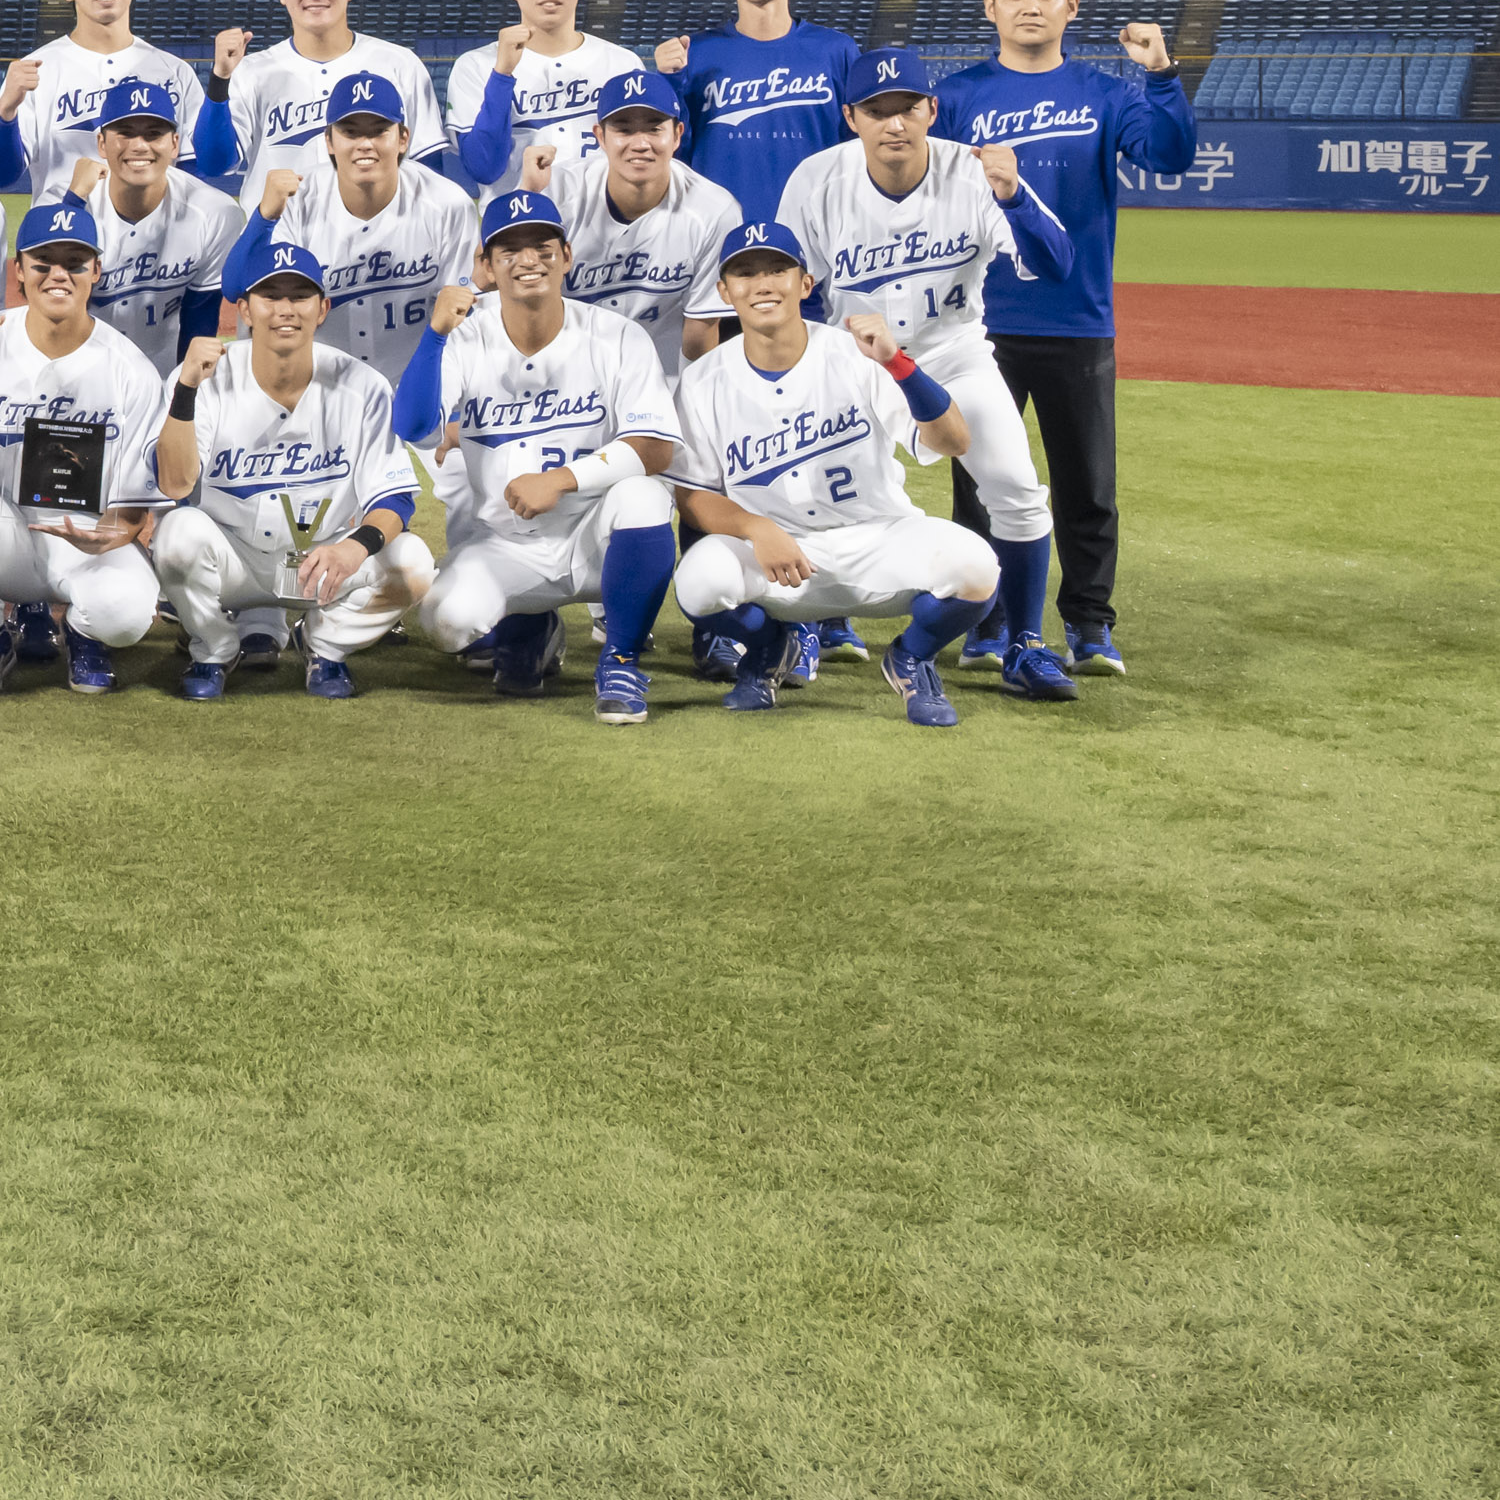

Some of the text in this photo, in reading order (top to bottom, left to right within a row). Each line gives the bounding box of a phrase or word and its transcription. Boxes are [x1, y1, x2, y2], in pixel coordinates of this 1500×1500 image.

[1317, 139, 1492, 175] 加賀電子
[1398, 174, 1490, 196] グループ
[384, 301, 425, 330] 16
[924, 284, 967, 319] 14
[826, 467, 858, 503] 2
